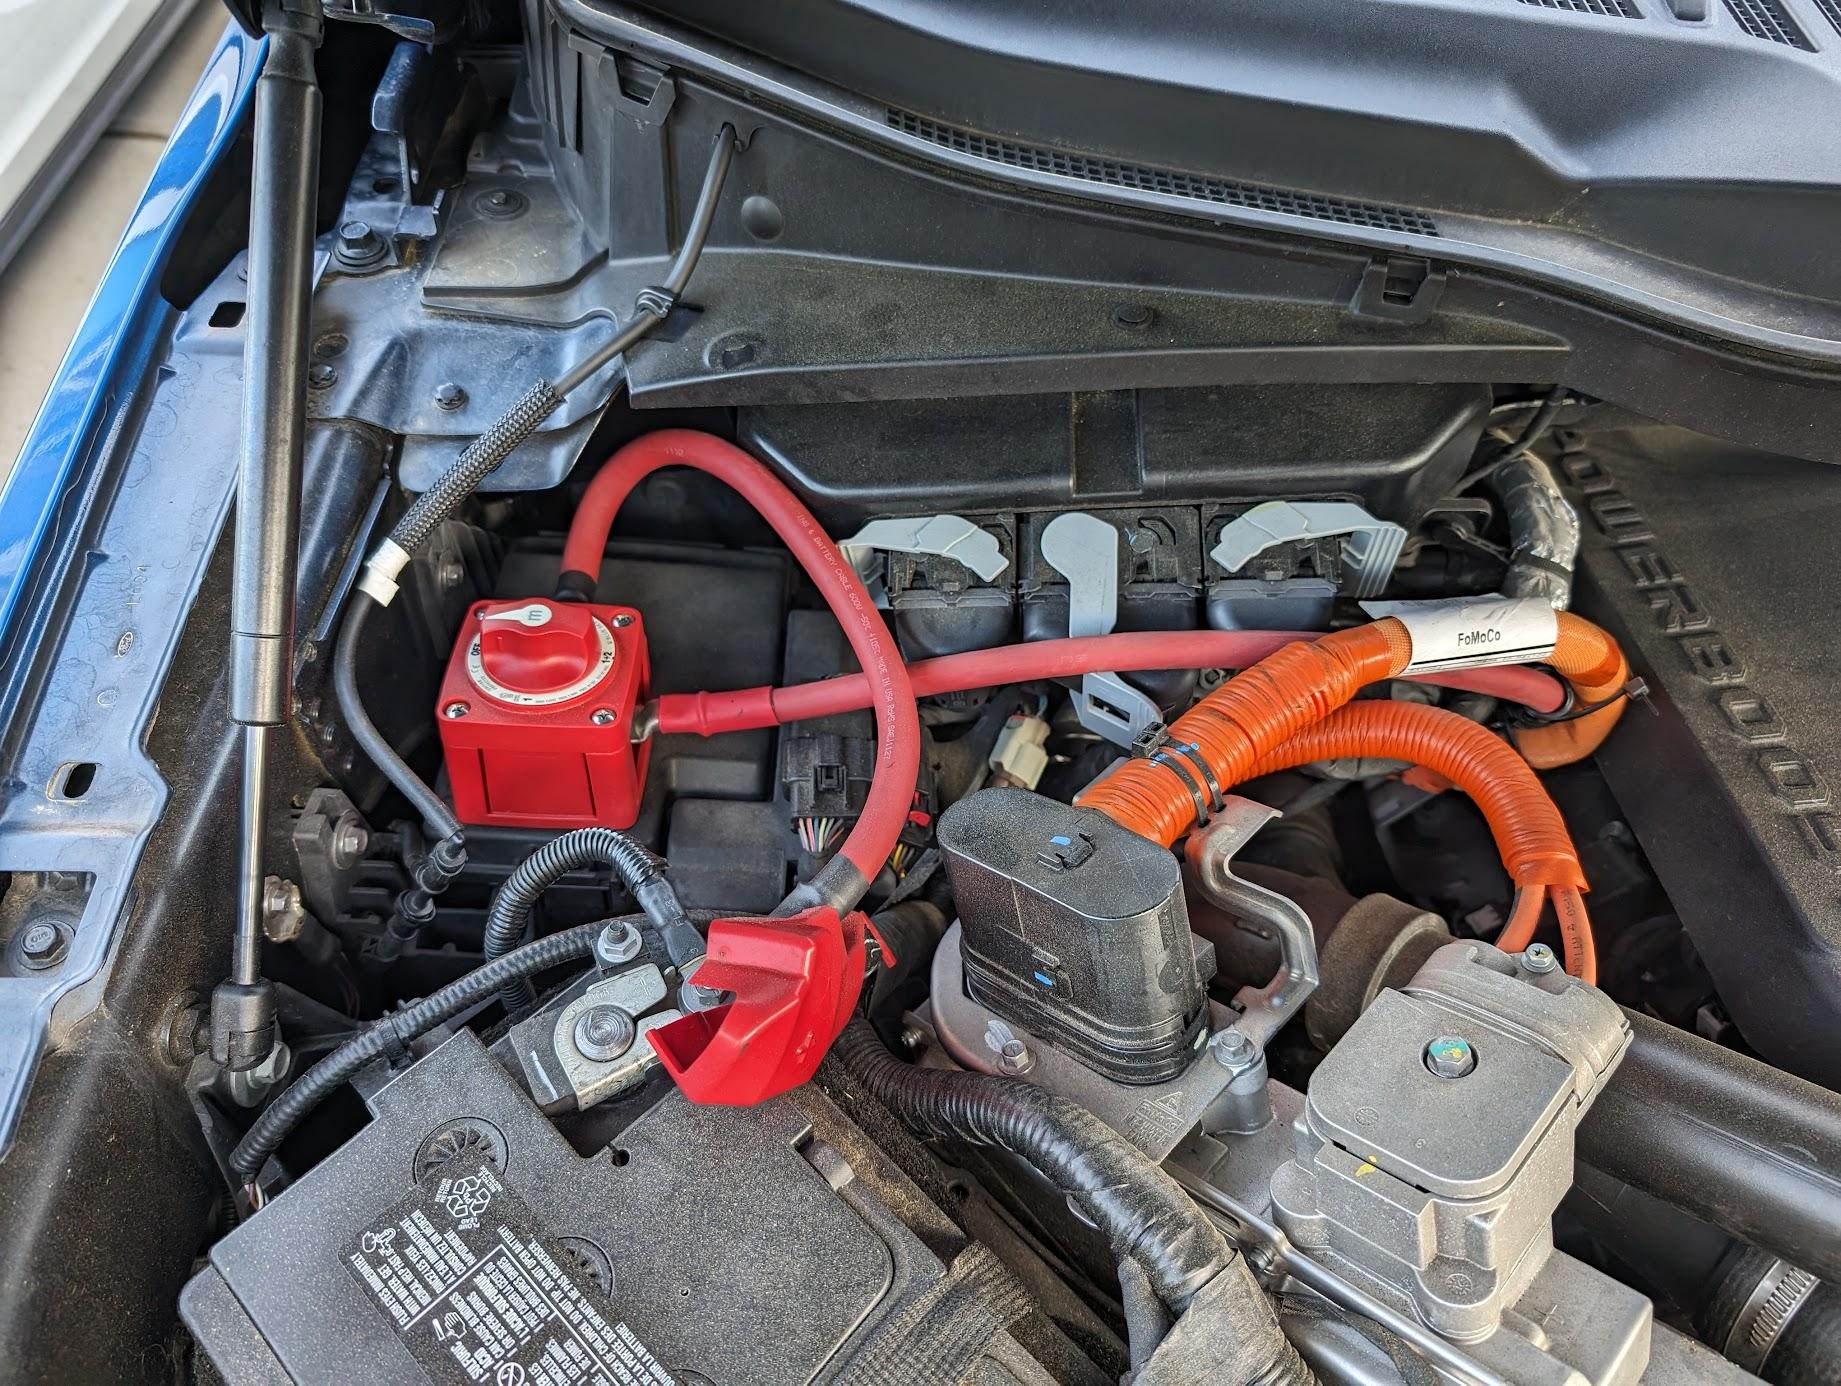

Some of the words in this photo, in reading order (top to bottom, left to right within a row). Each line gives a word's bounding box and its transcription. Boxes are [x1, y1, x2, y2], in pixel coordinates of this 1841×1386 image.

[814, 535, 838, 570] BATTERY
[835, 568, 852, 590] CABLE
[849, 589, 862, 611] 600V
[1457, 628, 1502, 646] FoMoCo
[879, 655, 888, 676] MADE
[882, 678, 890, 687] IN
[885, 687, 894, 703] USA
[478, 1170, 496, 1192] RECYCLE
[479, 1164, 503, 1192] RECYCLAGE
[462, 1191, 474, 1204] Pb
[410, 1209, 435, 1236] MÉDECIN
[429, 1232, 442, 1245] UN
[443, 1227, 476, 1266] RAPIDEMENT.
[496, 1224, 523, 1253] BATTERY!
[403, 1244, 421, 1263] YEUX
[436, 1240, 466, 1275] CONSULTEZ
[518, 1249, 536, 1268] OPEN
[528, 1238, 562, 1278] RENVERSER.
[349, 1252, 384, 1292] IMMEDIATELY
[377, 1263, 392, 1278] GET
[397, 1267, 414, 1284] HELP
[433, 1259, 452, 1280] L'EAU
[483, 1261, 495, 1273] OU
[496, 1256, 518, 1280] GRAVES
[530, 1265, 546, 1281] NOT
[387, 1274, 409, 1300] WATER.
[408, 1278, 431, 1306] MEDICAL
[473, 1272, 509, 1313] SULFURIQUE
[502, 1284, 514, 1296] LA
[541, 1276, 554, 1290] DO
[567, 1286, 580, 1300] NE
[377, 1287, 395, 1306] EYES
[402, 1295, 420, 1315] WITH
[466, 1291, 488, 1316] BURNS
[507, 1291, 529, 1314] CAUSER
[558, 1298, 574, 1314] NOT
[388, 1301, 410, 1325] FLUSH
[448, 1291, 479, 1327] BLINDNESS
[522, 1310, 539, 1327] PEUT
[534, 1302, 550, 1318] DES
[569, 1310, 582, 1324] DO
[482, 1311, 507, 1339] SEVERE
[502, 1308, 529, 1338] L'ACIDE
[473, 1322, 494, 1346] CAUSE
[501, 1334, 515, 1348] OR
[600, 1325, 616, 1343] DES
[614, 1321, 646, 1357] BATTERIE!
[473, 1346, 494, 1368] ACID
[488, 1341, 504, 1358] CAN
[563, 1338, 584, 1362] FUMER
[602, 1351, 616, 1363] OF
[641, 1352, 654, 1366] LA
[450, 1341, 483, 1379] SULFURIC
[528, 1362, 543, 1378] LES
[578, 1356, 591, 1370] DE
[632, 1362, 645, 1376] LA
[566, 1364, 581, 1380] LES
[610, 1359, 633, 1384] REACH
[638, 1371, 653, 1385] DE
